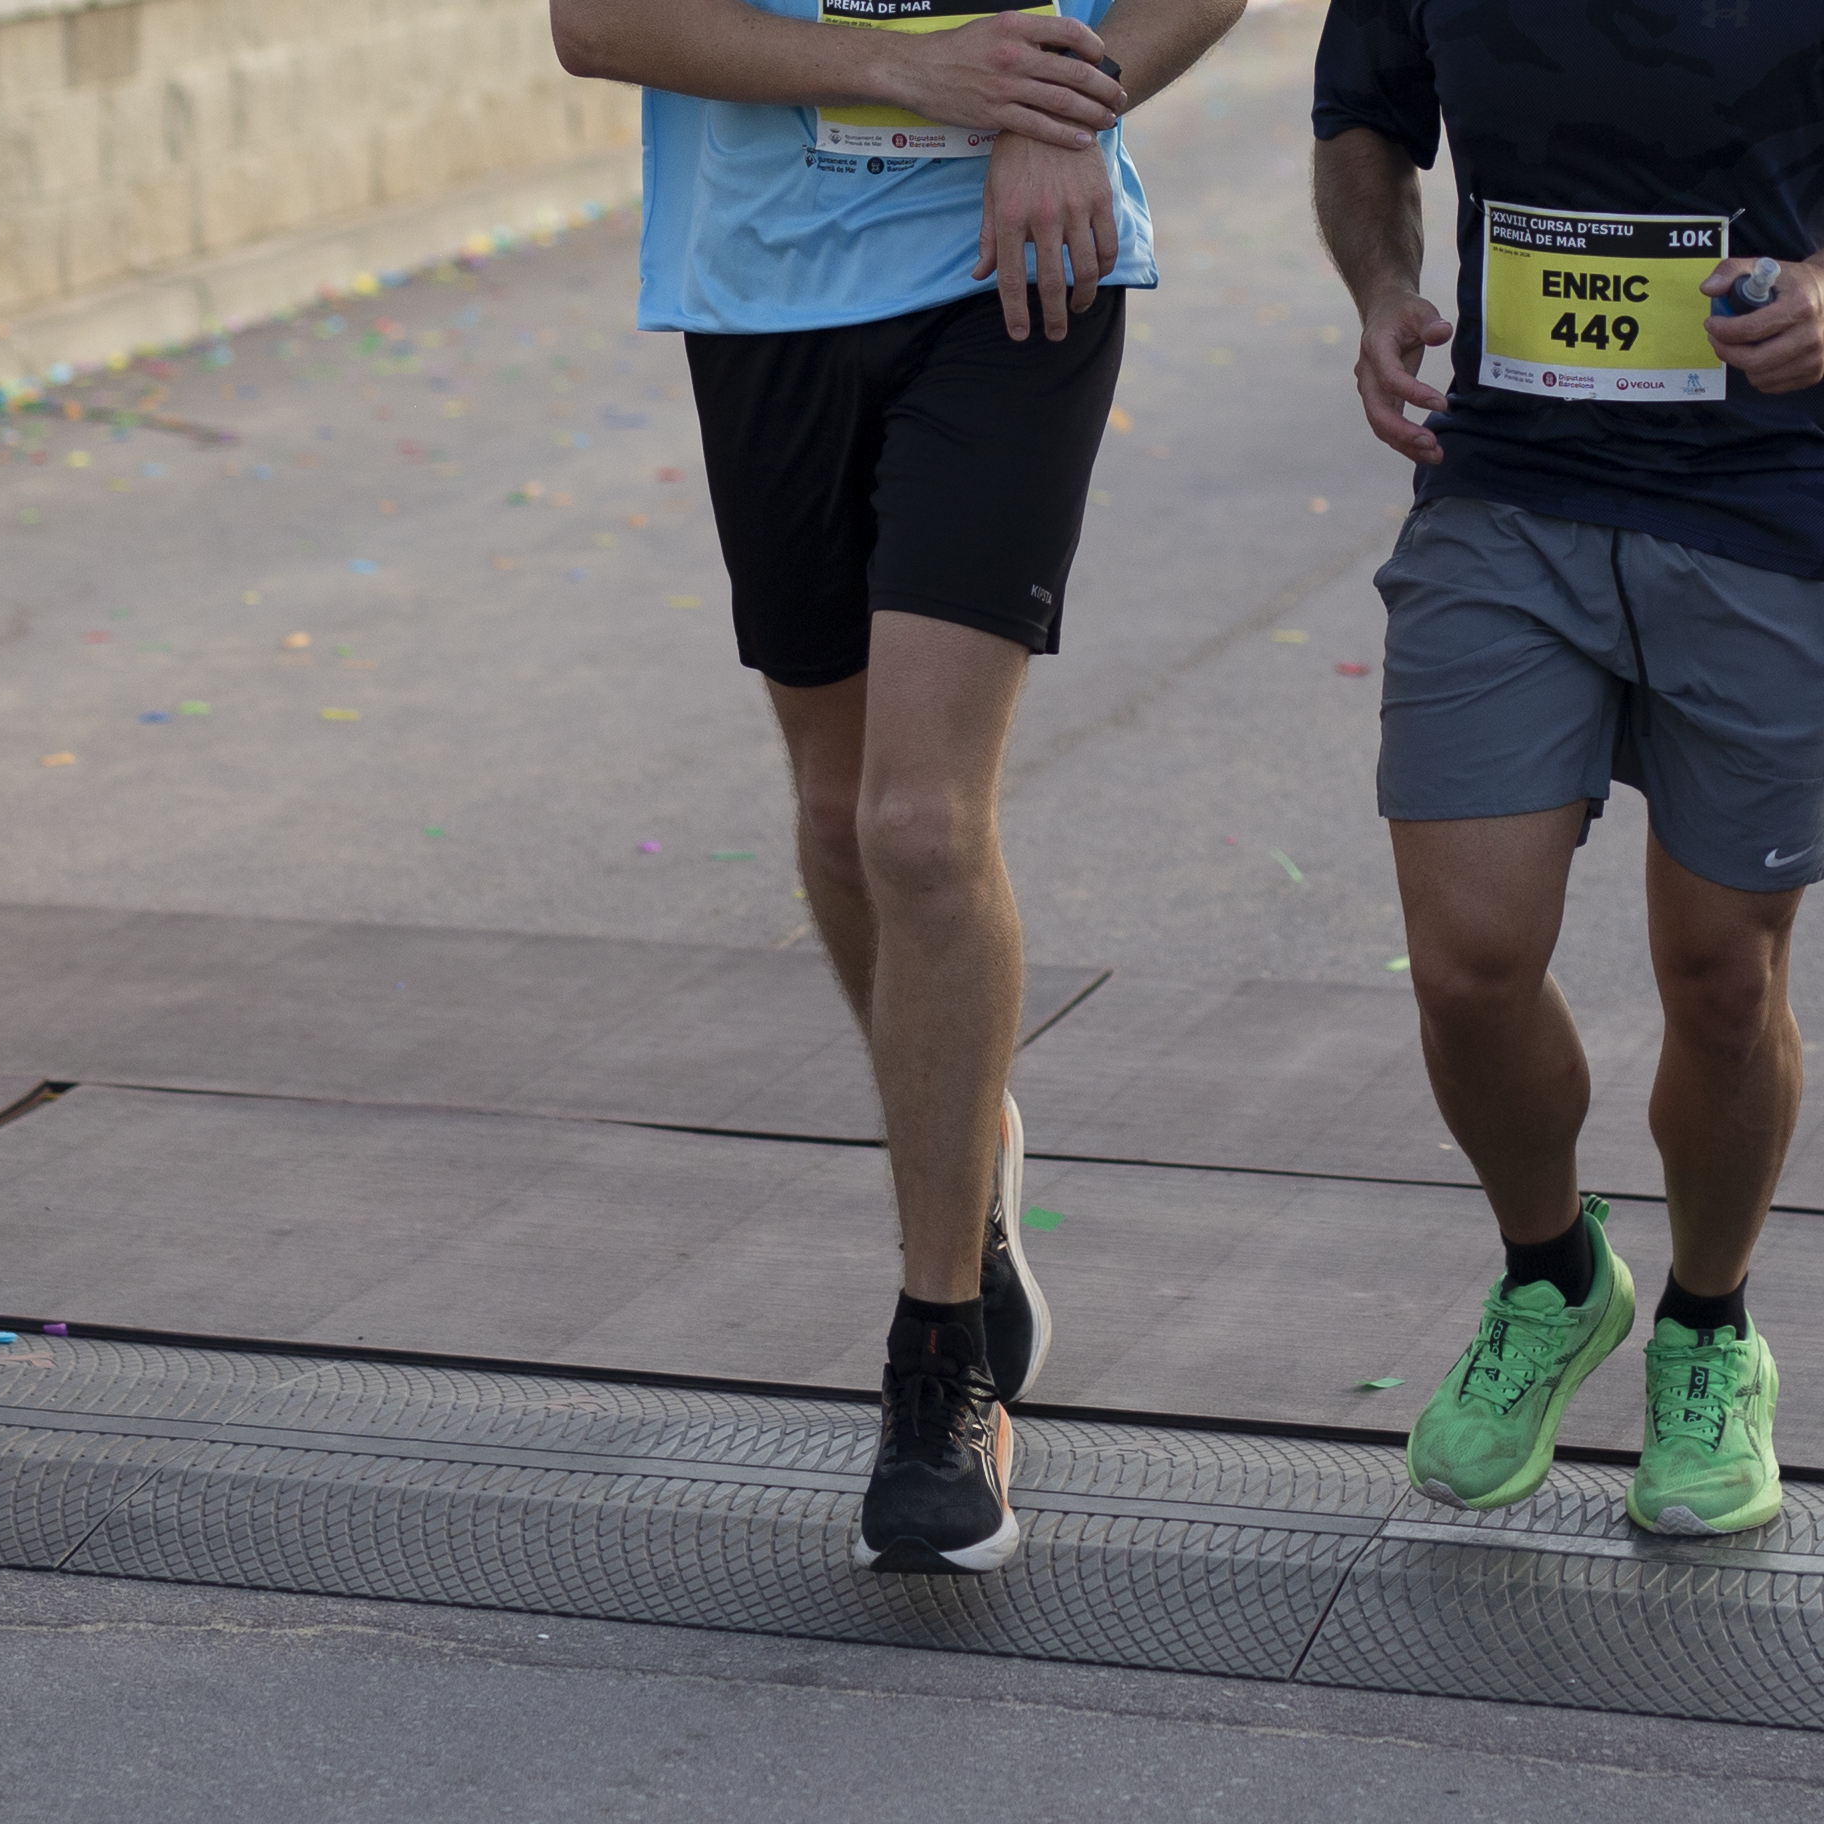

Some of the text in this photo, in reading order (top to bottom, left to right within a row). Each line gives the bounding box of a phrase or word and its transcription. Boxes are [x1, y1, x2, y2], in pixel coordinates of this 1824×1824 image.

[878, 2, 896, 14] DE
[900, 0, 932, 13] MAR
[908, 134, 946, 143] Diputació
[1492, 211, 1714, 247] XXVIII CURSA D'ESTIU 10K
[1493, 226, 1587, 248] PREMIÀ DE MAR
[1542, 269, 1651, 303] ENRIC
[1550, 312, 1640, 351] 449
[1558, 374, 1595, 383] Diputació
[1558, 381, 1595, 389] Barcelona
[1630, 380, 1666, 389] VEOLIA
